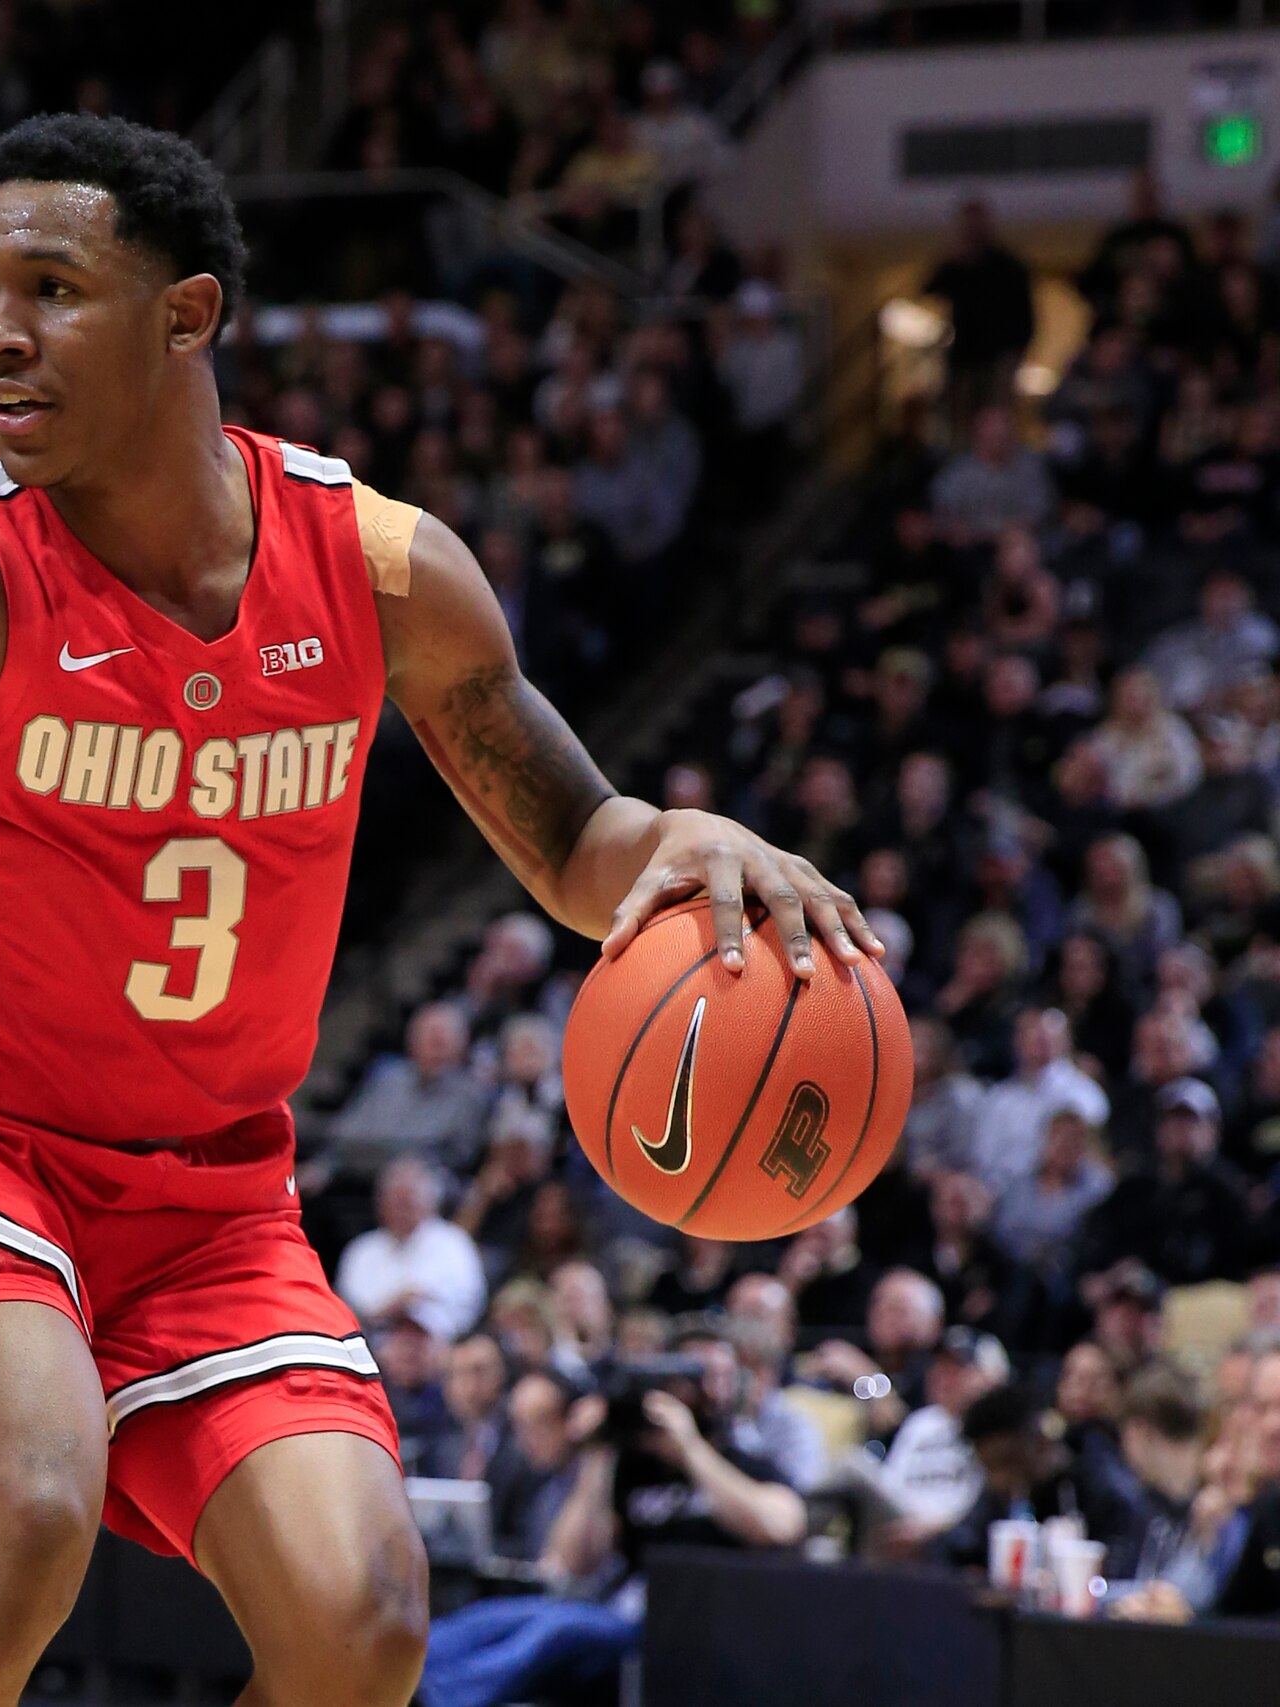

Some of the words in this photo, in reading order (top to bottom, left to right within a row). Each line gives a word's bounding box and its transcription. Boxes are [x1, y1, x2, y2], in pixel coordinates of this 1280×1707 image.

[16, 714, 183, 812] OHIO
[189, 717, 361, 821] STATE
[124, 836, 248, 1022] 3
[759, 1080, 832, 1200] P
